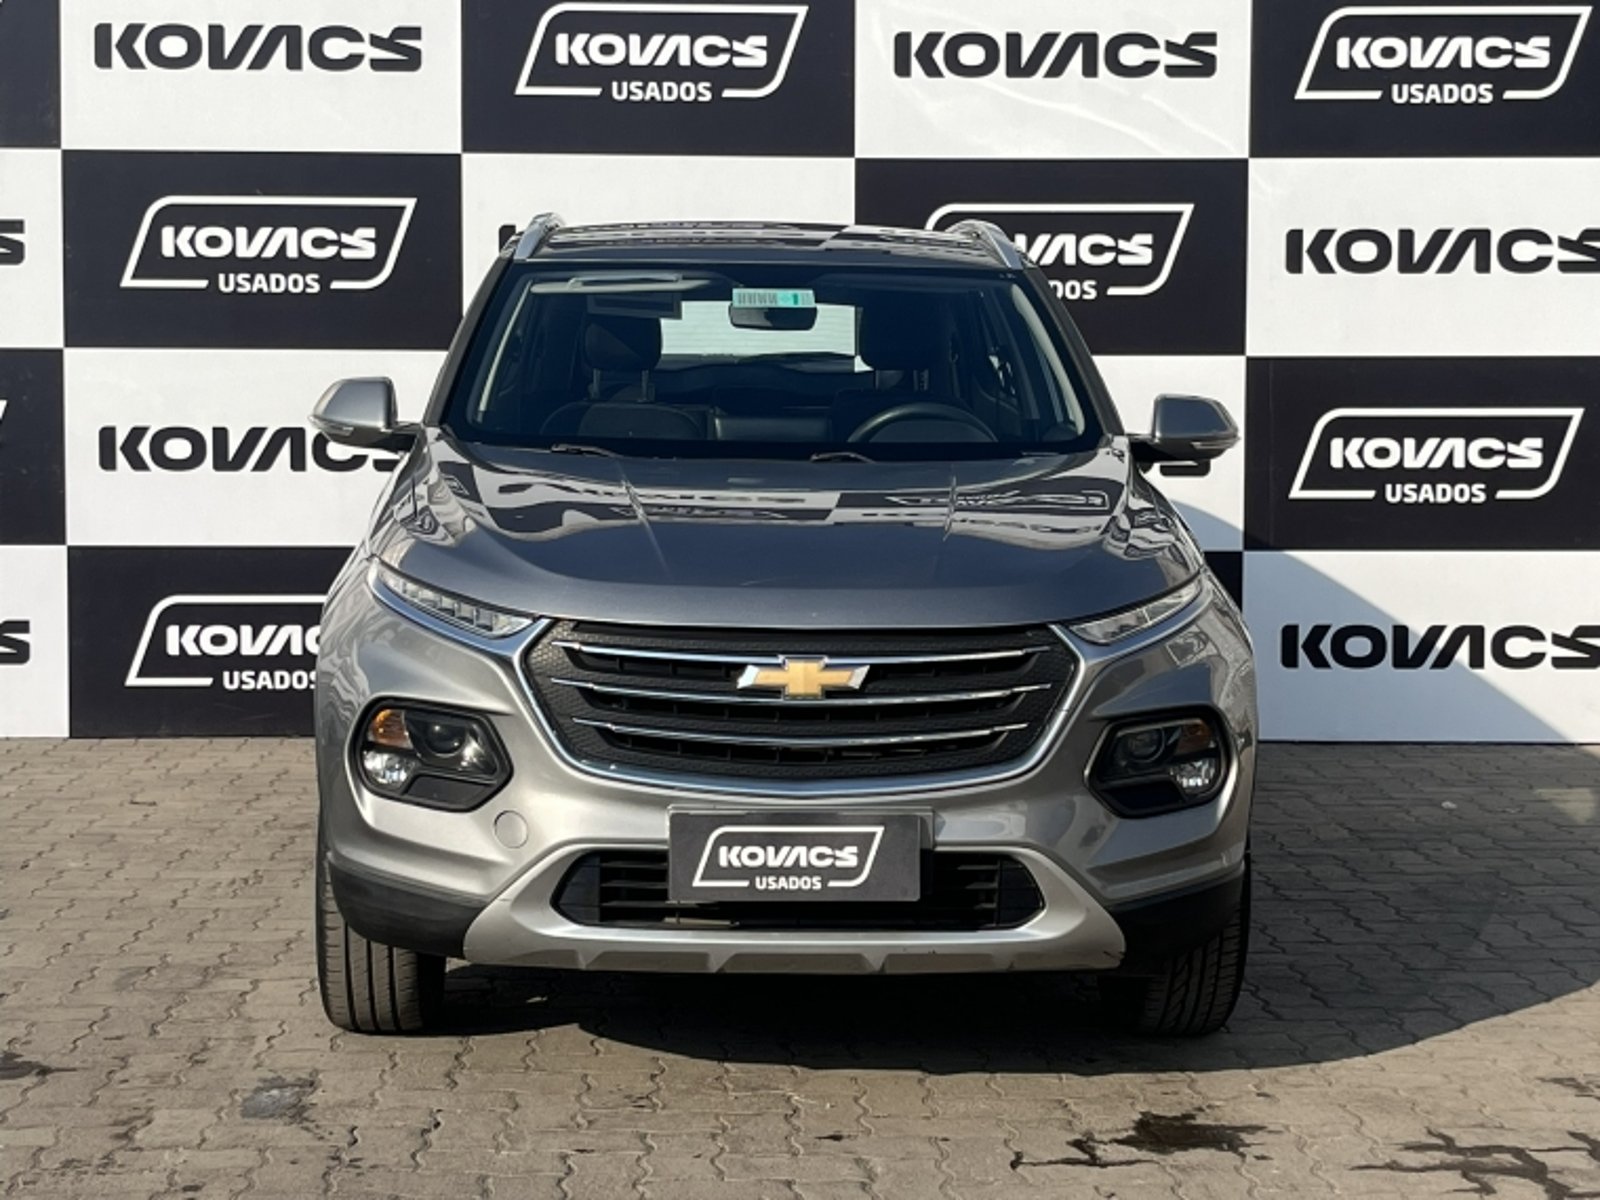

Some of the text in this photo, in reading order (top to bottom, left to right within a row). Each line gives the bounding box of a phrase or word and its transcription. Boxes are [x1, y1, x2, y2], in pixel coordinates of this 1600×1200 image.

[94, 23, 422, 72] KOVACS
[555, 33, 768, 67] KOVACS
[894, 31, 1218, 79] KOVACS
[1336, 36, 1551, 69] KOVACS
[611, 81, 712, 102] USADOS
[1391, 83, 1494, 104] USADOS
[161, 225, 376, 259] KOVACS
[1014, 233, 1153, 266] VACS
[1285, 228, 1600, 274] KOVACS
[218, 273, 321, 294] USADOS
[98, 426, 400, 472] KOVAC
[1330, 437, 1543, 469] KOVACS
[1385, 483, 1487, 503] USADOS
[166, 624, 320, 656] KOVA
[1279, 623, 1600, 670] KOVACS
[718, 845, 859, 868] KOVACS
[755, 875, 822, 890] USADOS
